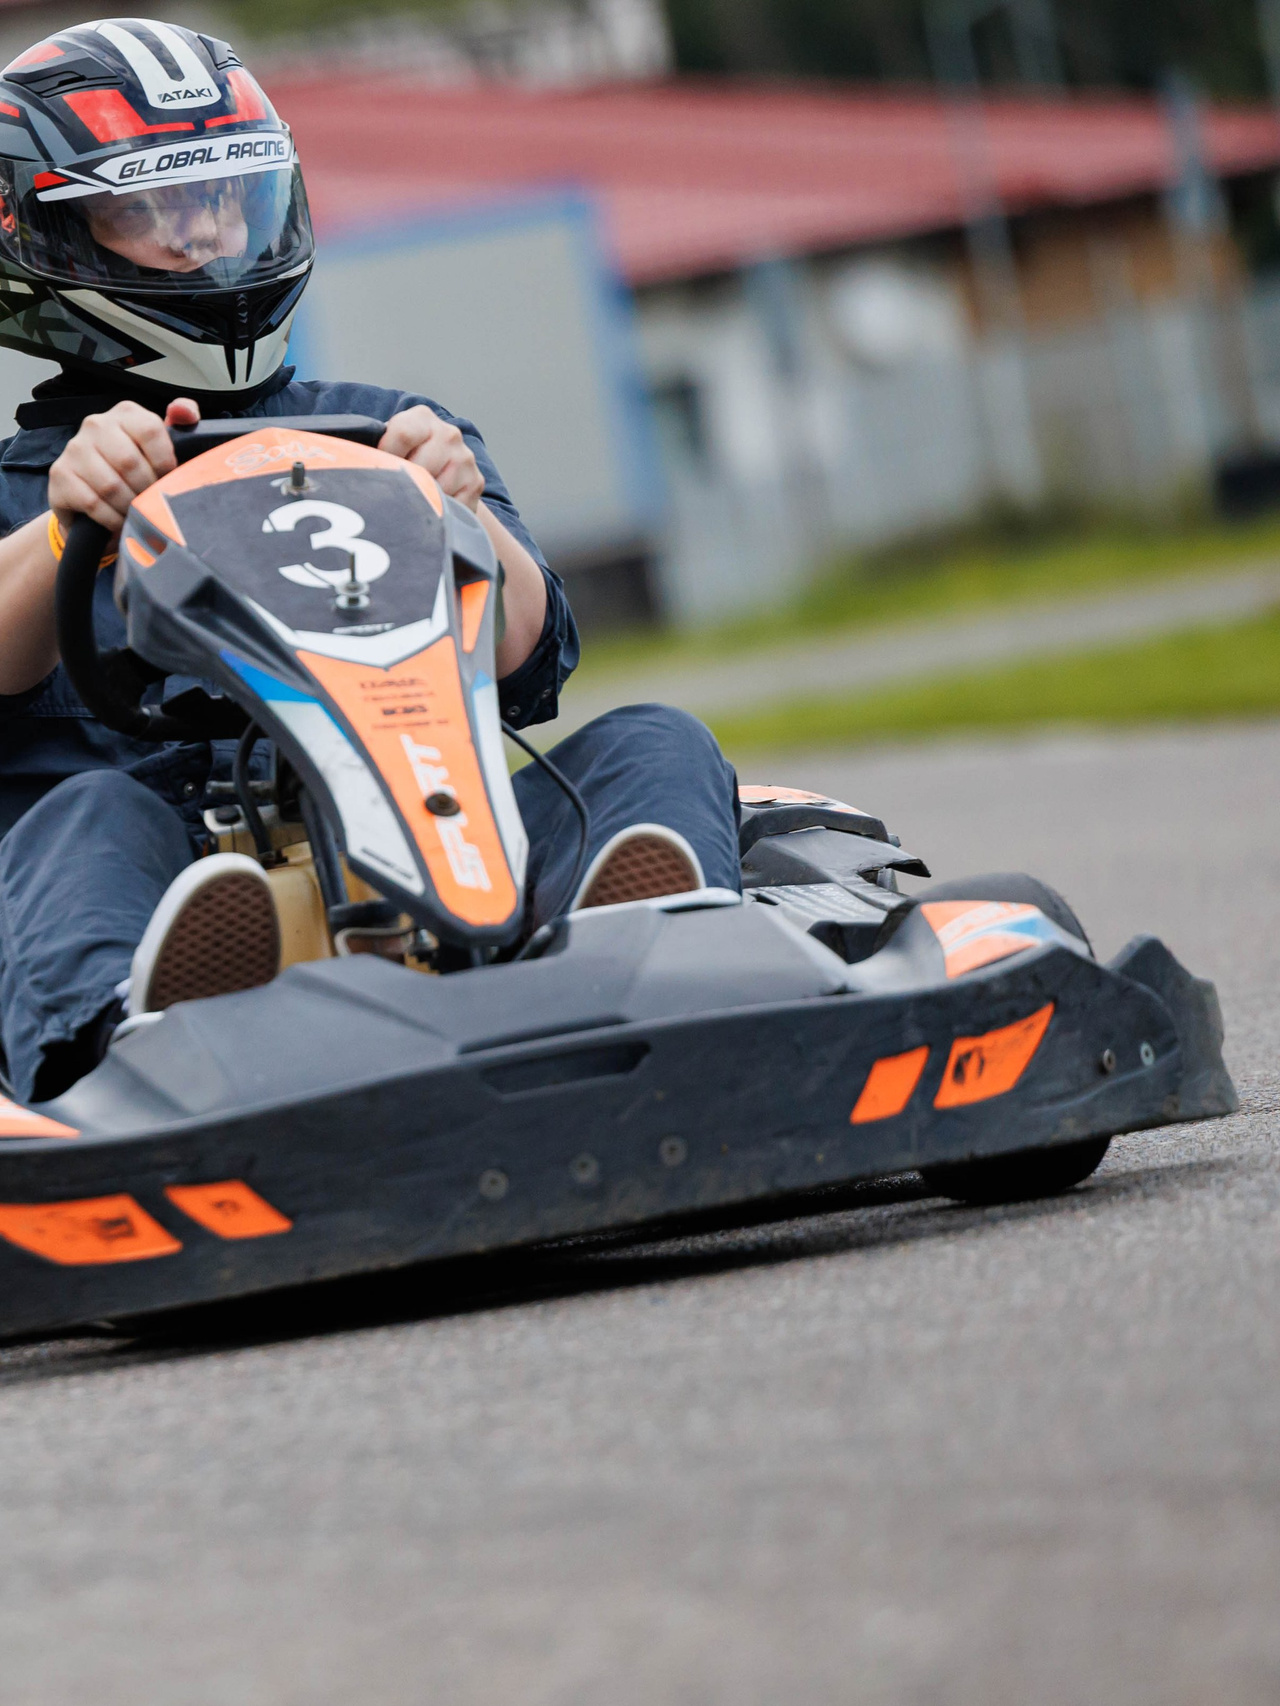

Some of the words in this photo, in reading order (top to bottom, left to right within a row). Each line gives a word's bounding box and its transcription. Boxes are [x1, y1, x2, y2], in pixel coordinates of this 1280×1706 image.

[158, 87, 213, 104] ATAKI
[118, 146, 222, 180] GLOBAL
[225, 140, 286, 161] RACING
[261, 499, 391, 589] 3
[399, 733, 493, 893] SPRT
